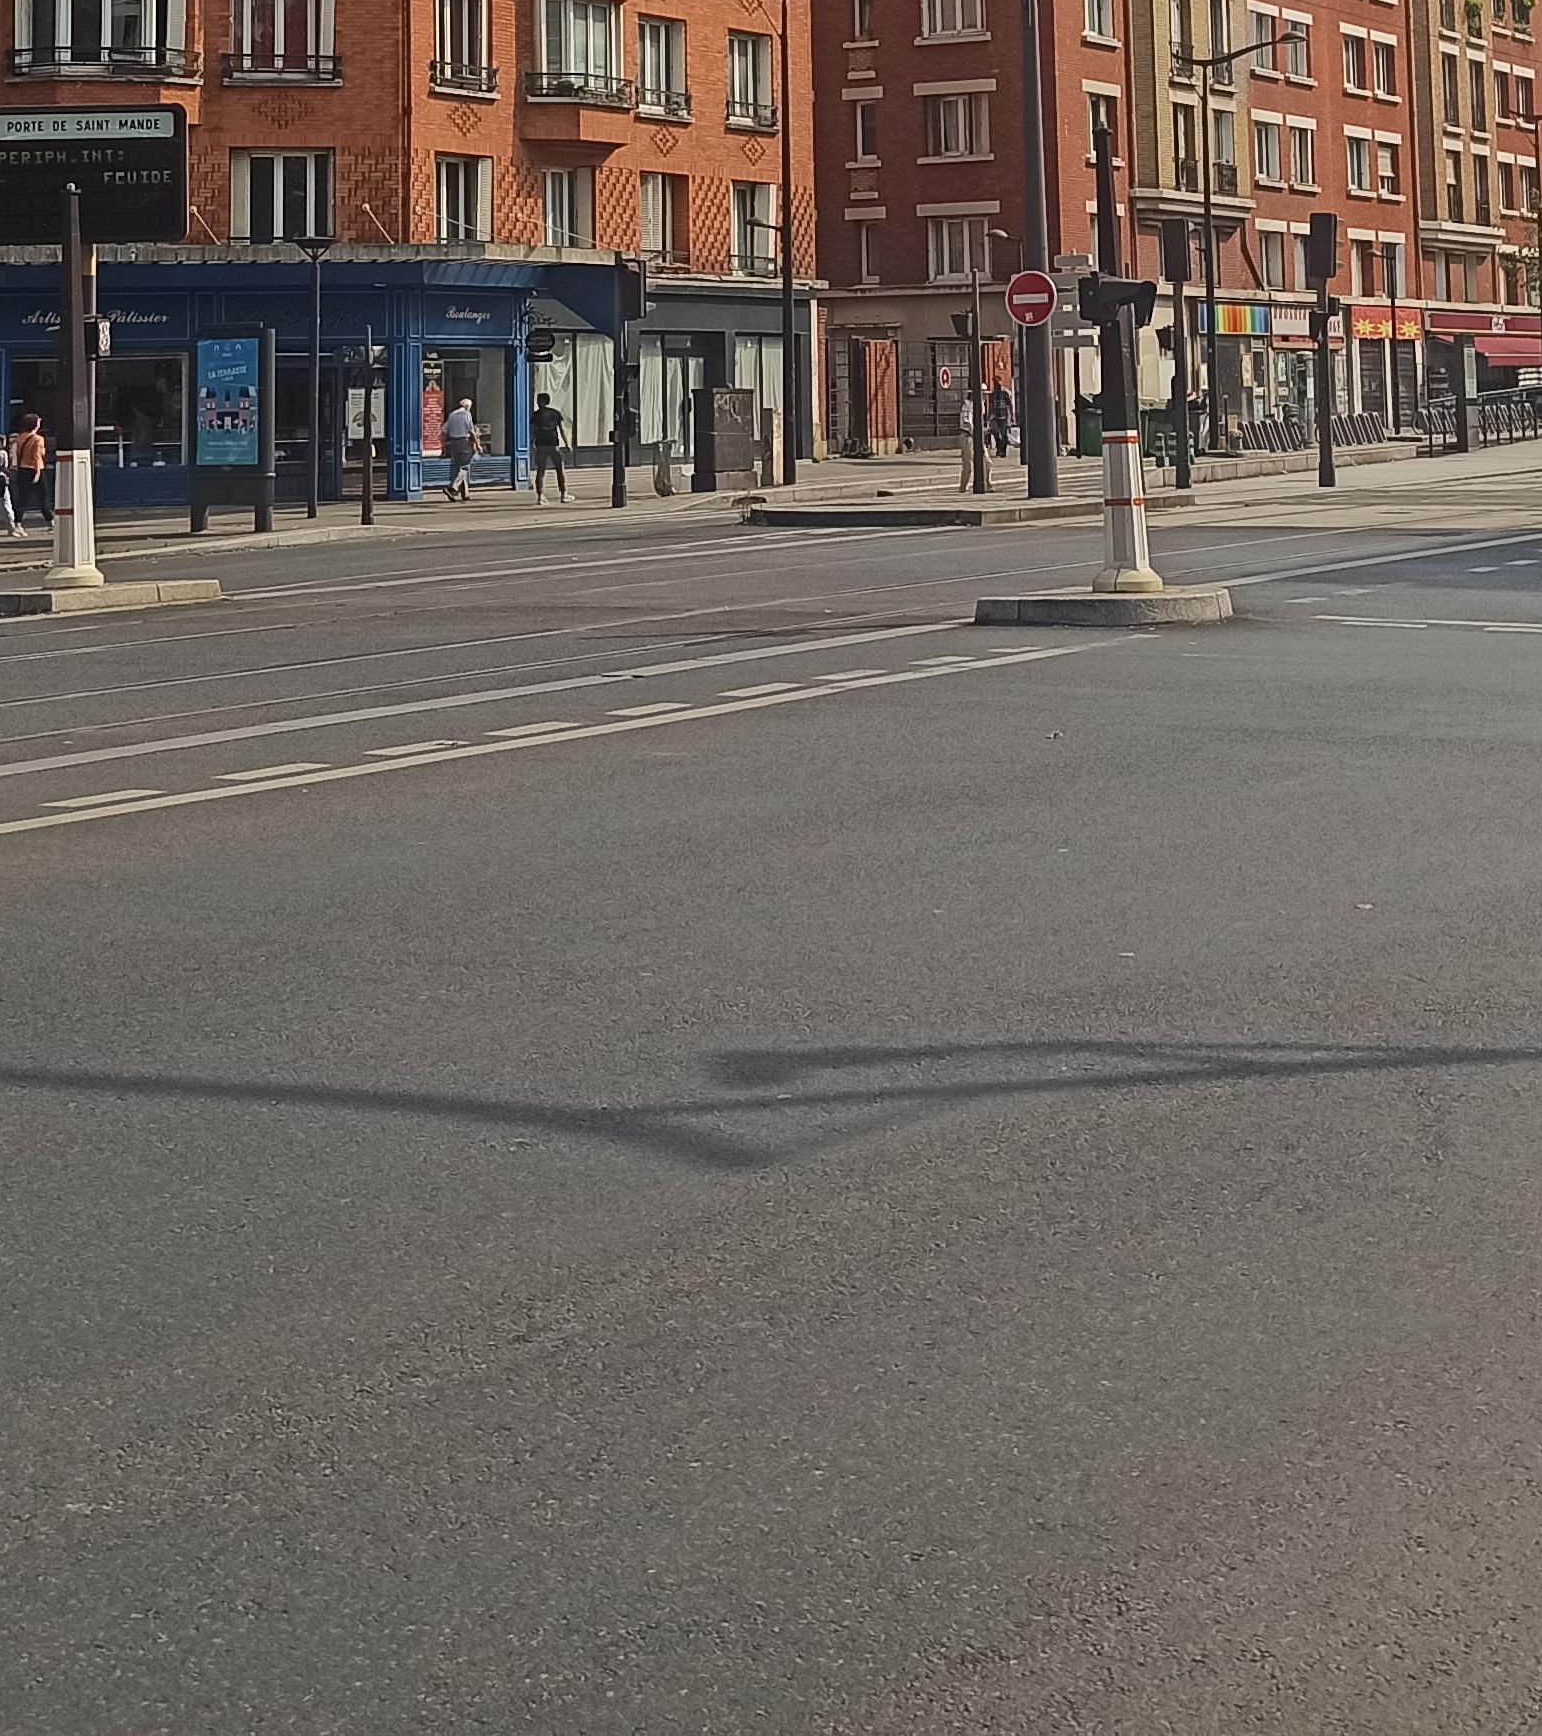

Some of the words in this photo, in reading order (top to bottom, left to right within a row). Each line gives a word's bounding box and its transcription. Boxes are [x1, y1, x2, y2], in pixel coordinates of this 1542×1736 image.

[7, 120, 44, 133] PORTE
[53, 120, 67, 131] DE
[76, 119, 110, 131] SAINT
[118, 118, 160, 130] MANDE
[445, 305, 491, 325] Boulanger
